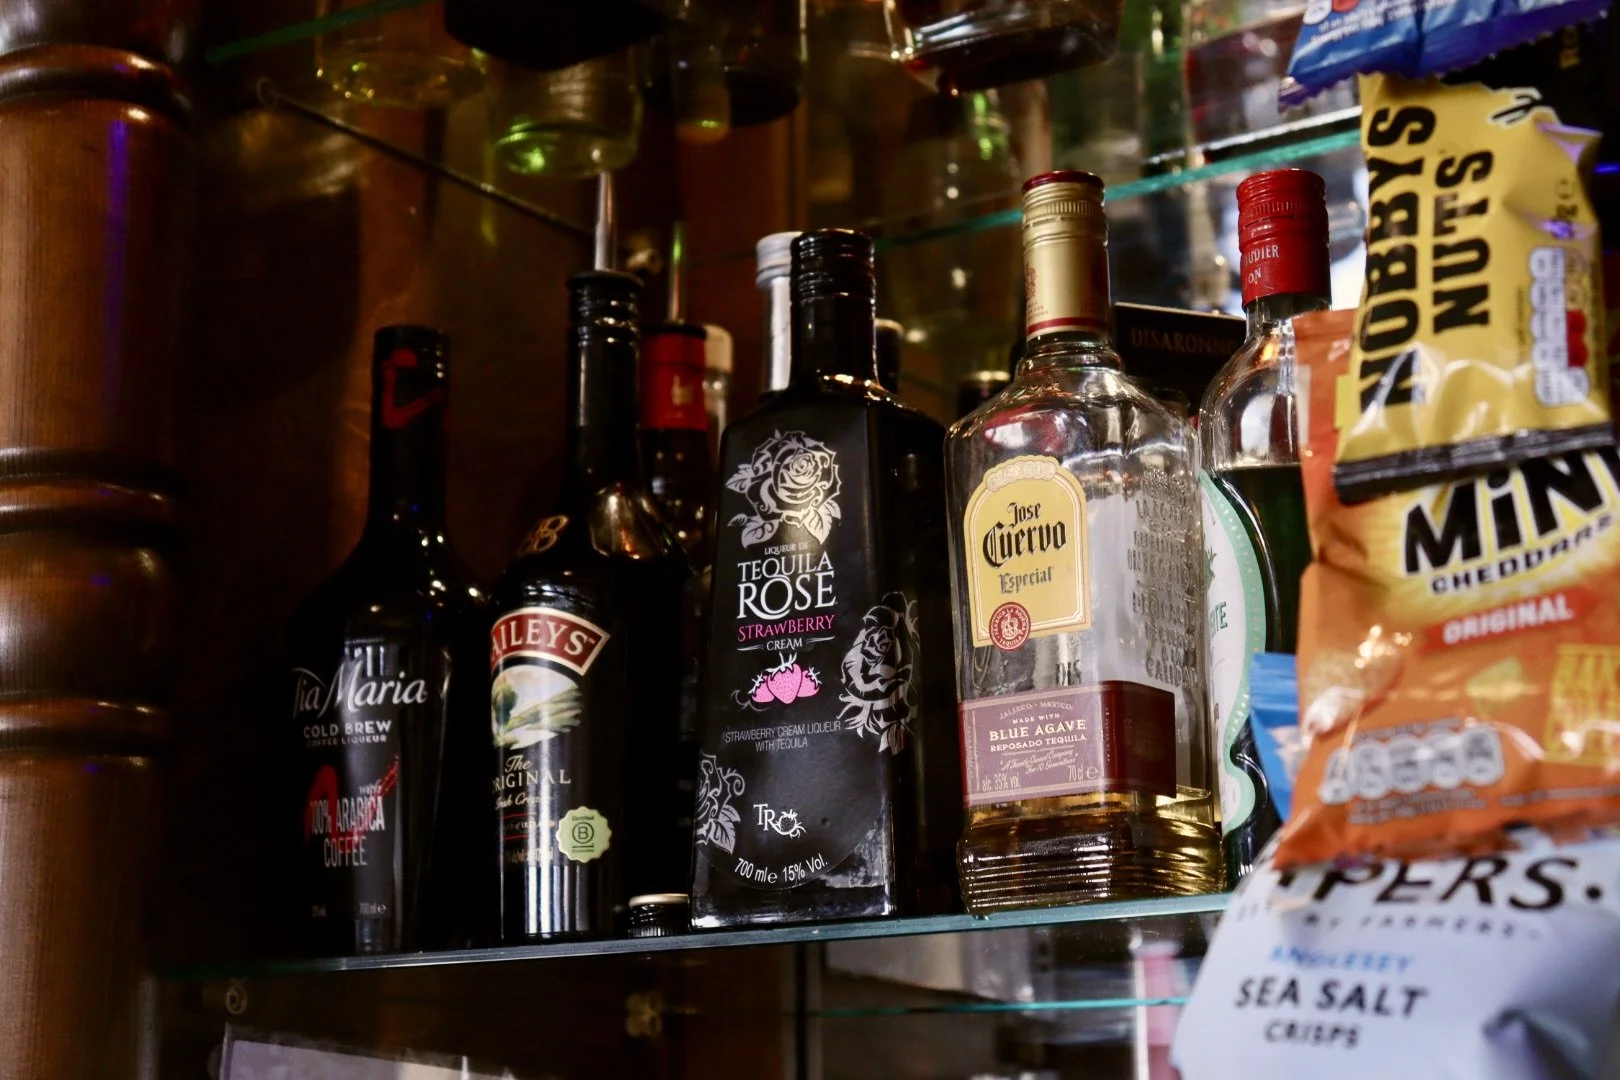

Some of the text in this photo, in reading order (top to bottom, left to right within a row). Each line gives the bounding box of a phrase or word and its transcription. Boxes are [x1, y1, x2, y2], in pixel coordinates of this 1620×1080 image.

[1433, 150, 1494, 336] NUTS
[1007, 502, 1041, 528] Jose
[764, 543, 796, 555] LIQUEUR
[982, 520, 1066, 568] Cuervo
[1431, 514, 1612, 595] CHEDDARS
[737, 551, 834, 582] TEQUILA
[998, 566, 1053, 594] Especial
[737, 570, 836, 620] ROSE
[738, 614, 836, 642] STRAWBERRY
[1442, 593, 1574, 645] ORIGINAL
[492, 618, 589, 656] AILEYS
[766, 637, 803, 651] CREAM
[289, 659, 428, 719] Tia Maria
[303, 719, 392, 739] COLD BREW
[725, 720, 841, 743] STRAWBERRY CREAM LIQUEUR
[989, 719, 1088, 742] BLUE AGAVE
[1012, 712, 1060, 724] MADE WITH
[341, 734, 387, 745] LIQUEUR
[755, 736, 808, 752] WITH TEQUILA
[990, 733, 1088, 753] REPOSADO TEQUILA
[504, 754, 532, 773] The
[493, 768, 572, 792] RIGINAL
[335, 795, 386, 833] ARABICA
[324, 835, 367, 868] COFFEE
[735, 857, 754, 879] 700
[782, 862, 806, 882] 15%
[806, 852, 828, 873] Vol.
[1233, 976, 1429, 1021] SEA SALT
[1264, 1018, 1359, 1050] CRISPS
